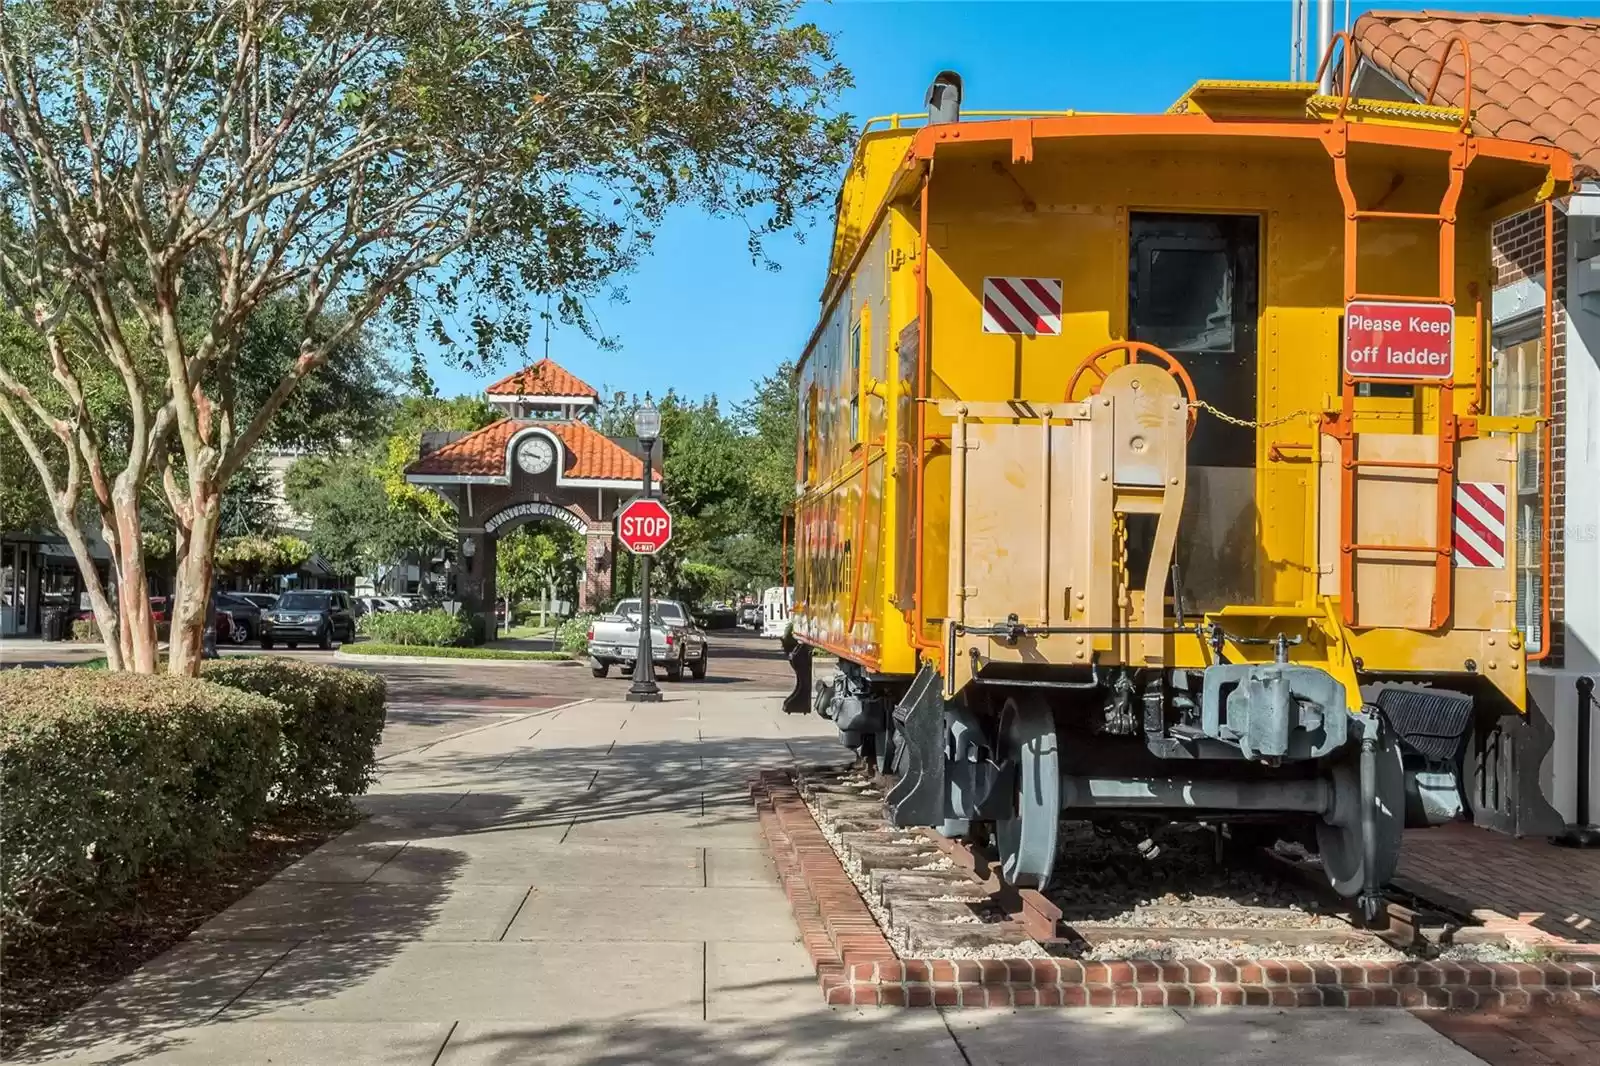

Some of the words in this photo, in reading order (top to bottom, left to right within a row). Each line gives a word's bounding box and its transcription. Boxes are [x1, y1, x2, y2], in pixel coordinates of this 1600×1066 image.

[1349, 315, 1402, 331] Please
[1409, 317, 1450, 336] Keep
[1350, 346, 1379, 363] off
[1387, 347, 1448, 365] ladder
[488, 503, 531, 528] WINTER
[537, 503, 585, 531] GARDEN
[623, 516, 667, 537] STOP
